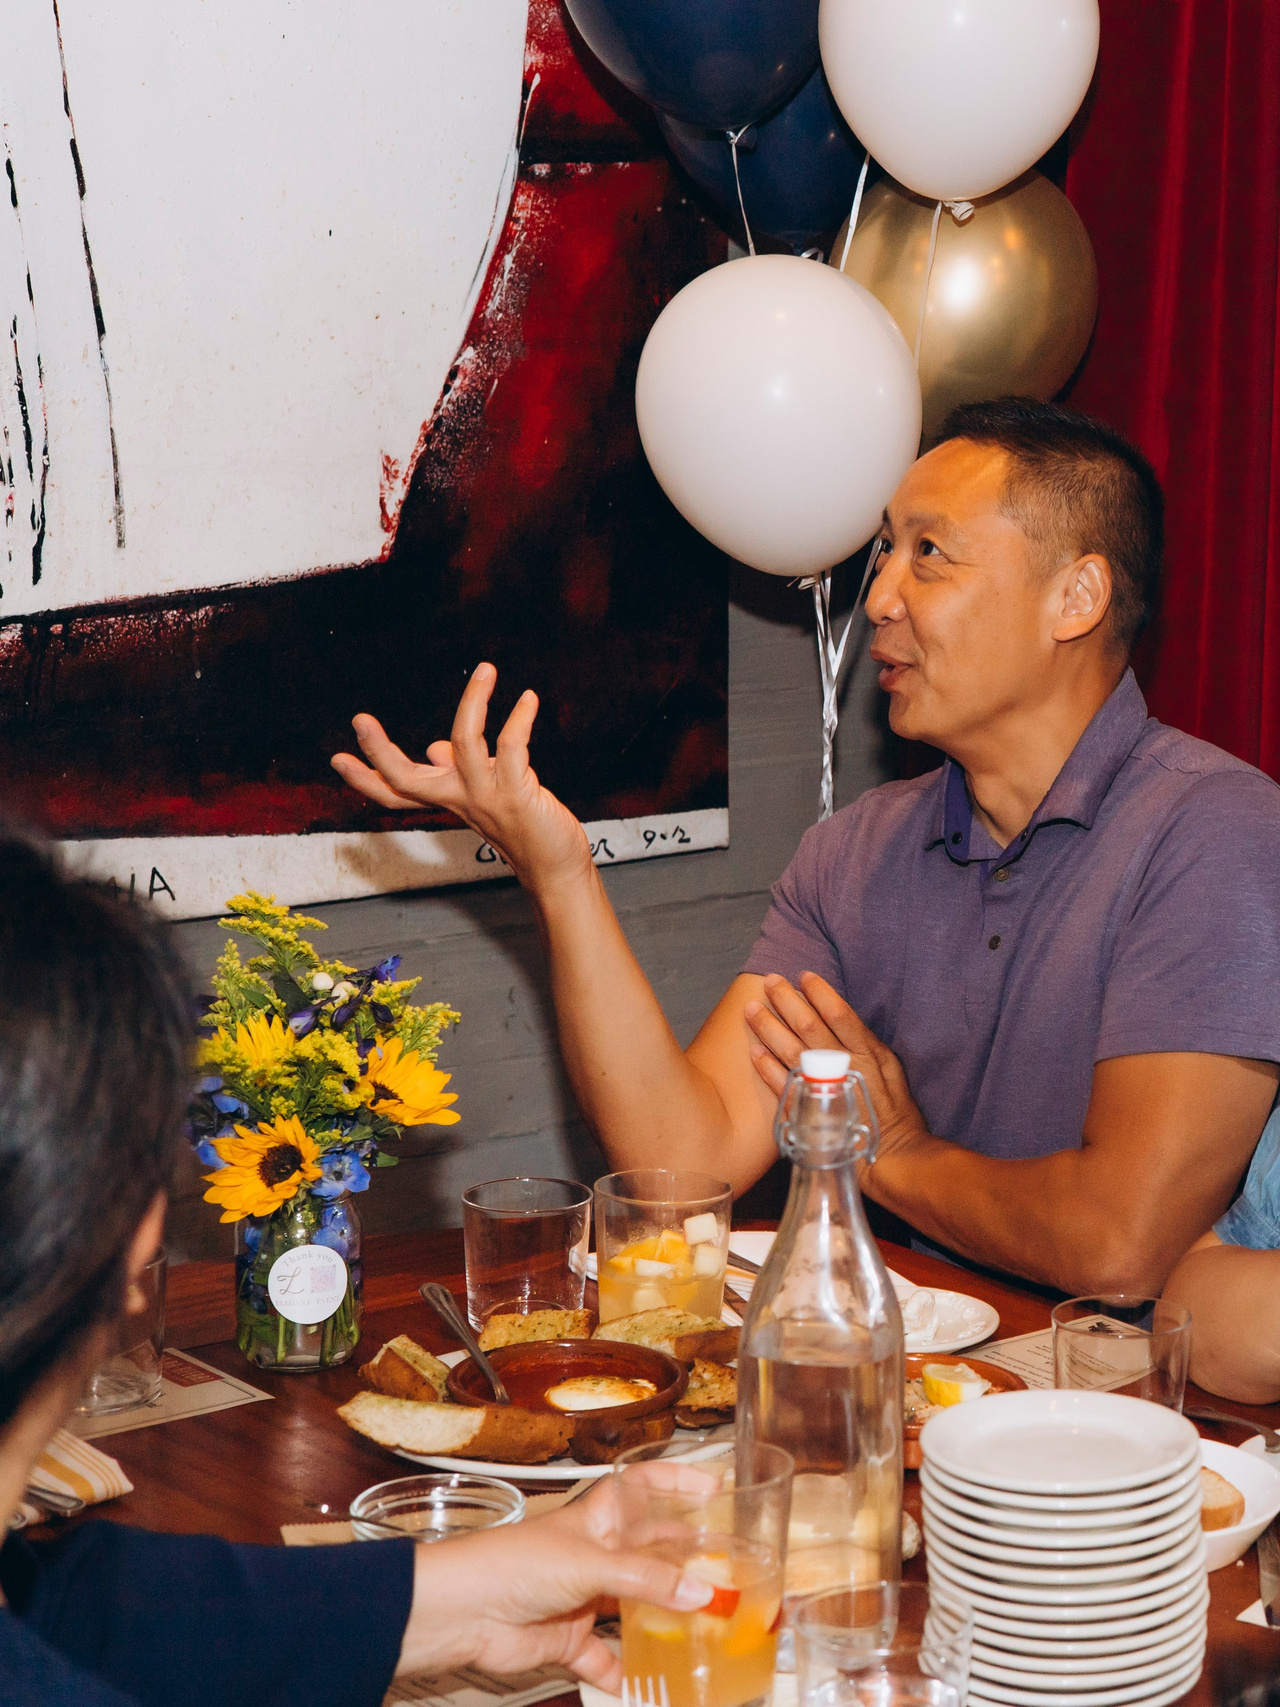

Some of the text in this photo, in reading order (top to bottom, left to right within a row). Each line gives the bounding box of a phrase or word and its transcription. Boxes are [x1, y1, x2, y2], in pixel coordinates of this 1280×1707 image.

[281, 1250, 334, 1267] Thank you
[275, 1299, 311, 1307] ELEGANT
